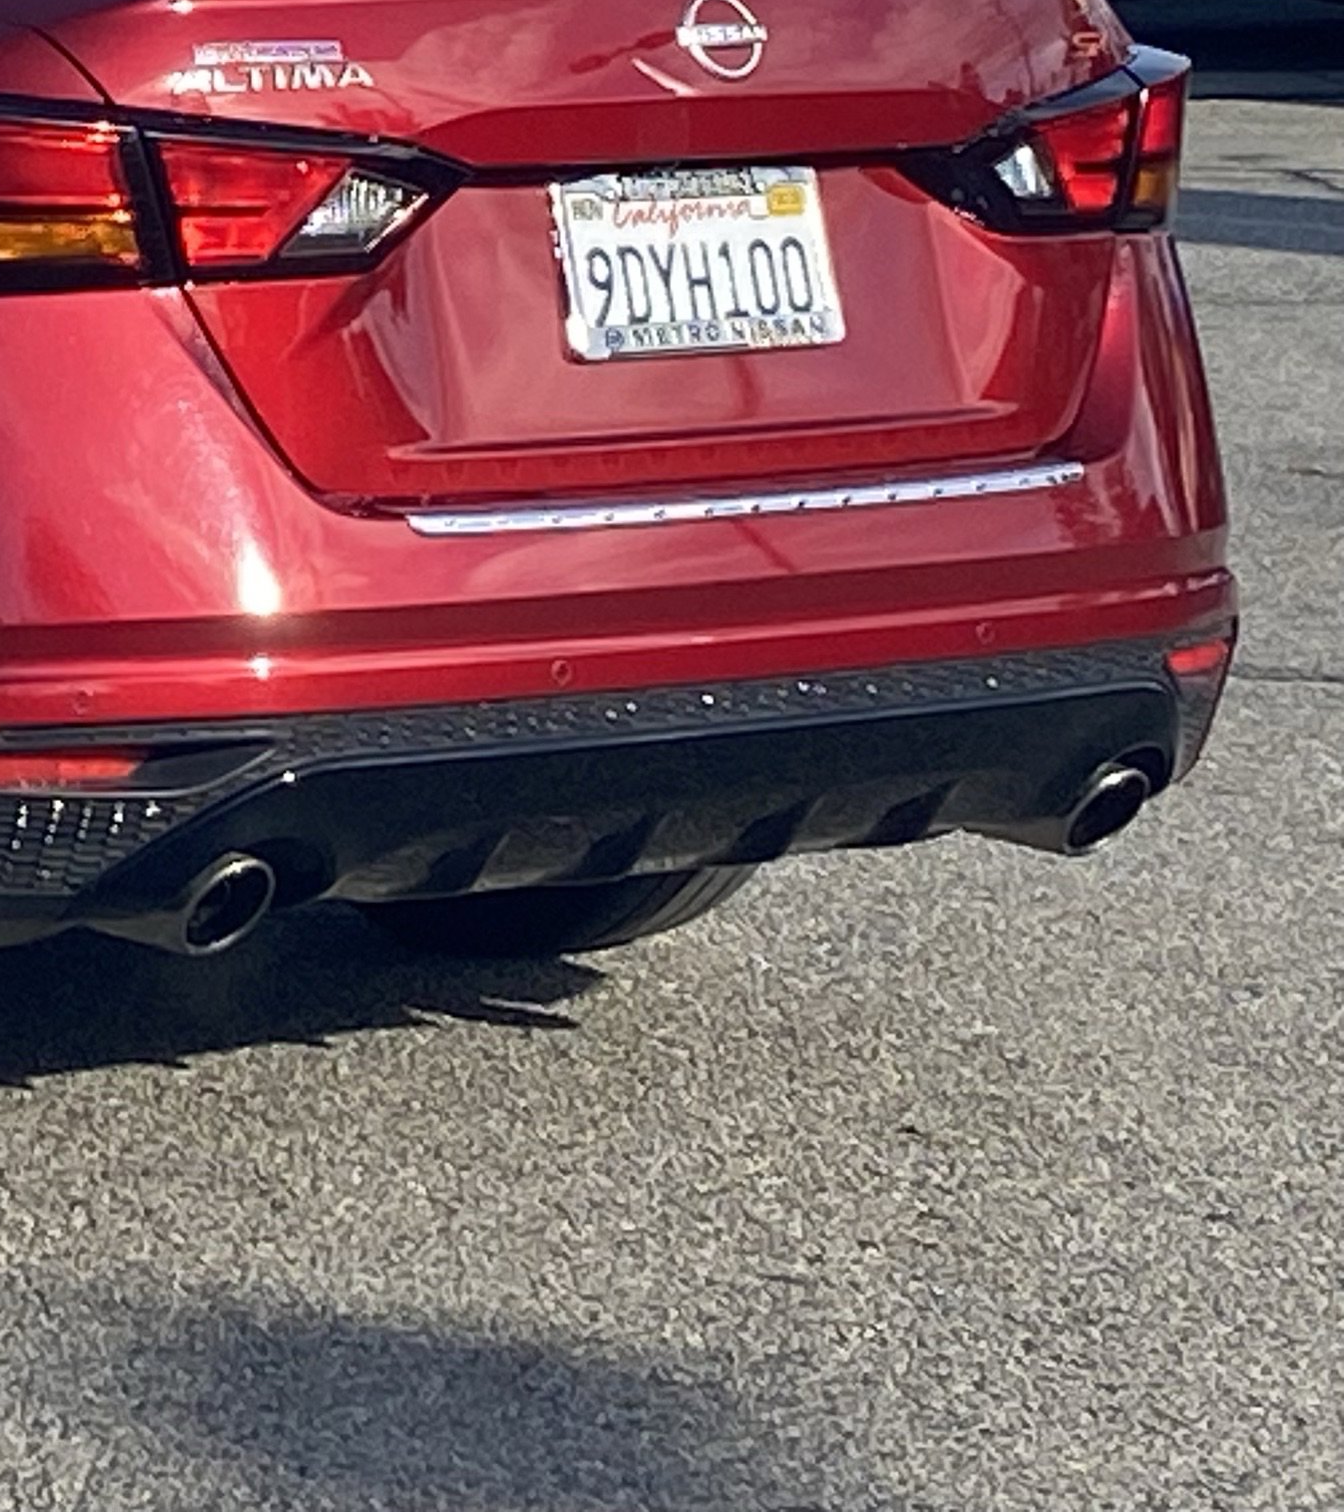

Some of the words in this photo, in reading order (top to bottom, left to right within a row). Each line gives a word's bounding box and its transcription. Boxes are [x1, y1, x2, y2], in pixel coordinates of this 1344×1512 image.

[613, 194, 753, 237] California
[585, 236, 815, 328] 9DYH100
[631, 323, 721, 347] METRO
